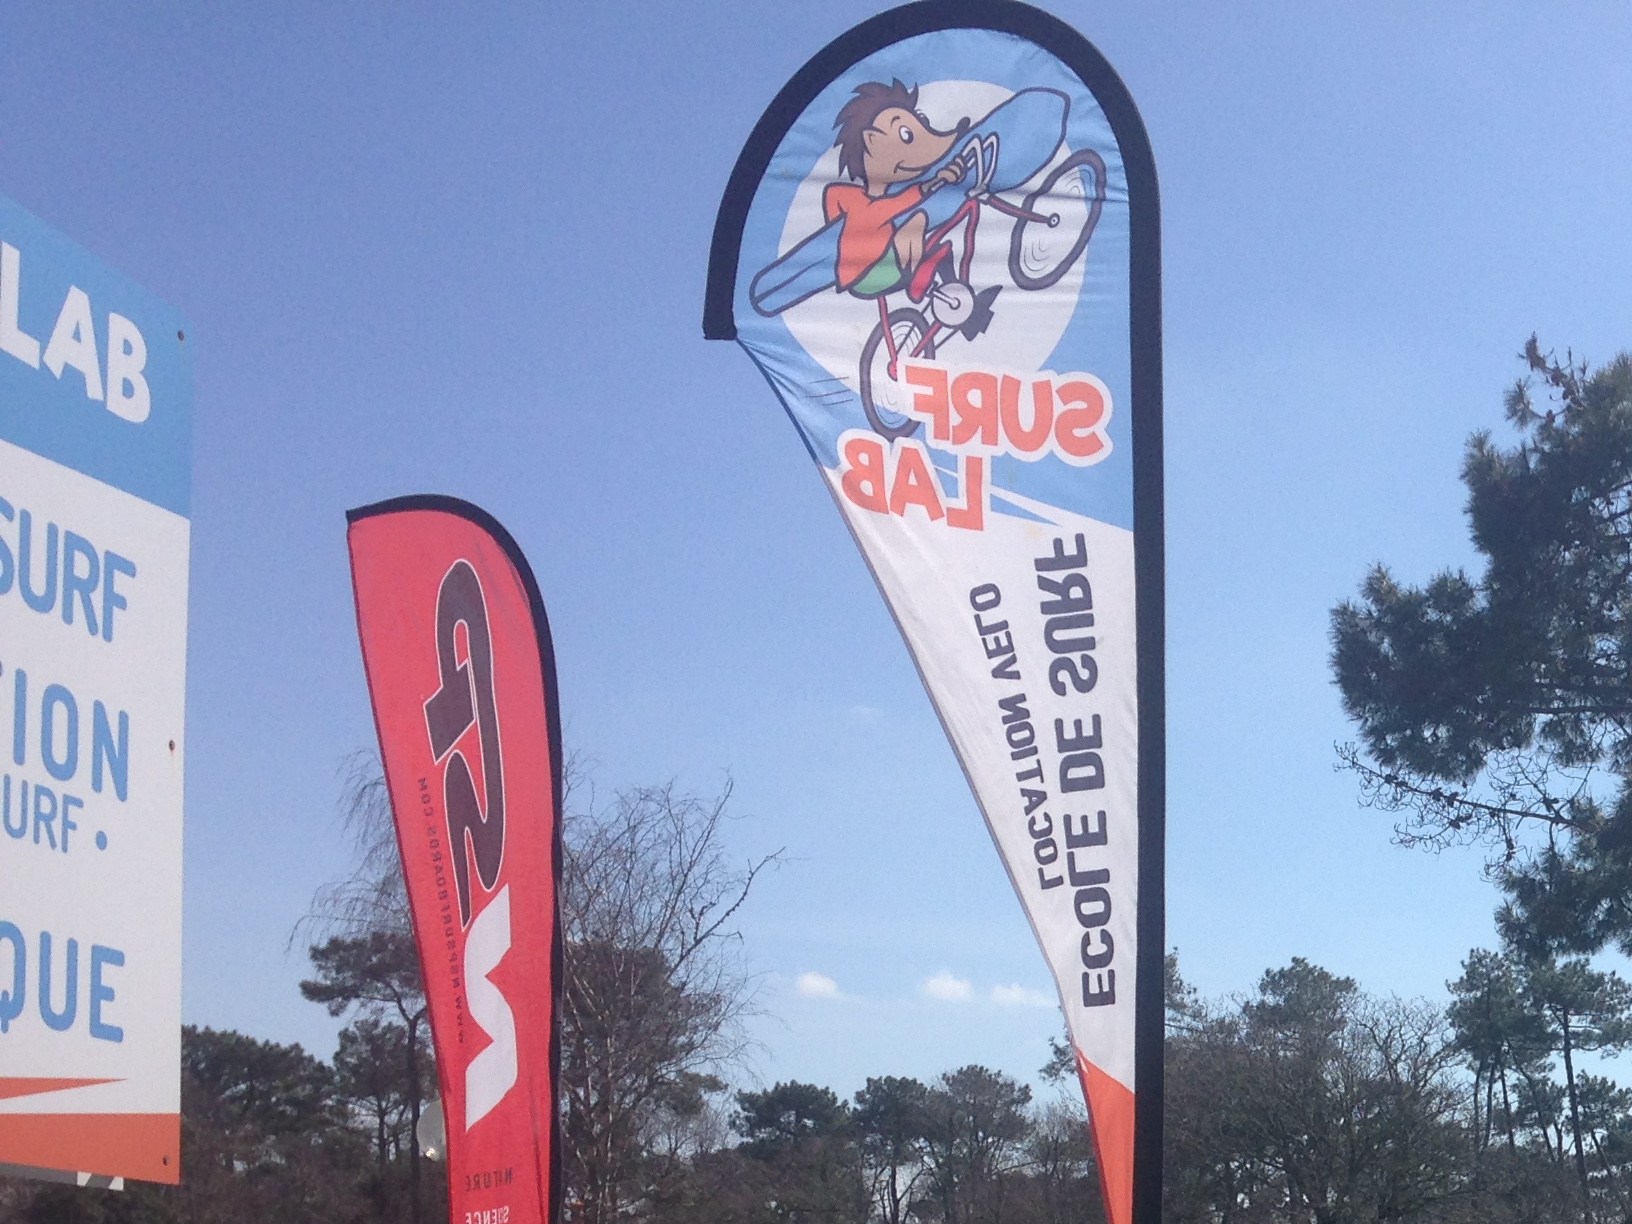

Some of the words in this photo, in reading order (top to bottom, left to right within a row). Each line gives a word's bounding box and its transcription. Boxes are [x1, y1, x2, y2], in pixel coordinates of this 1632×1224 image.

[0, 241, 151, 424] LAB
[0, 660, 129, 802] ION
[0, 920, 125, 1043] QUE
